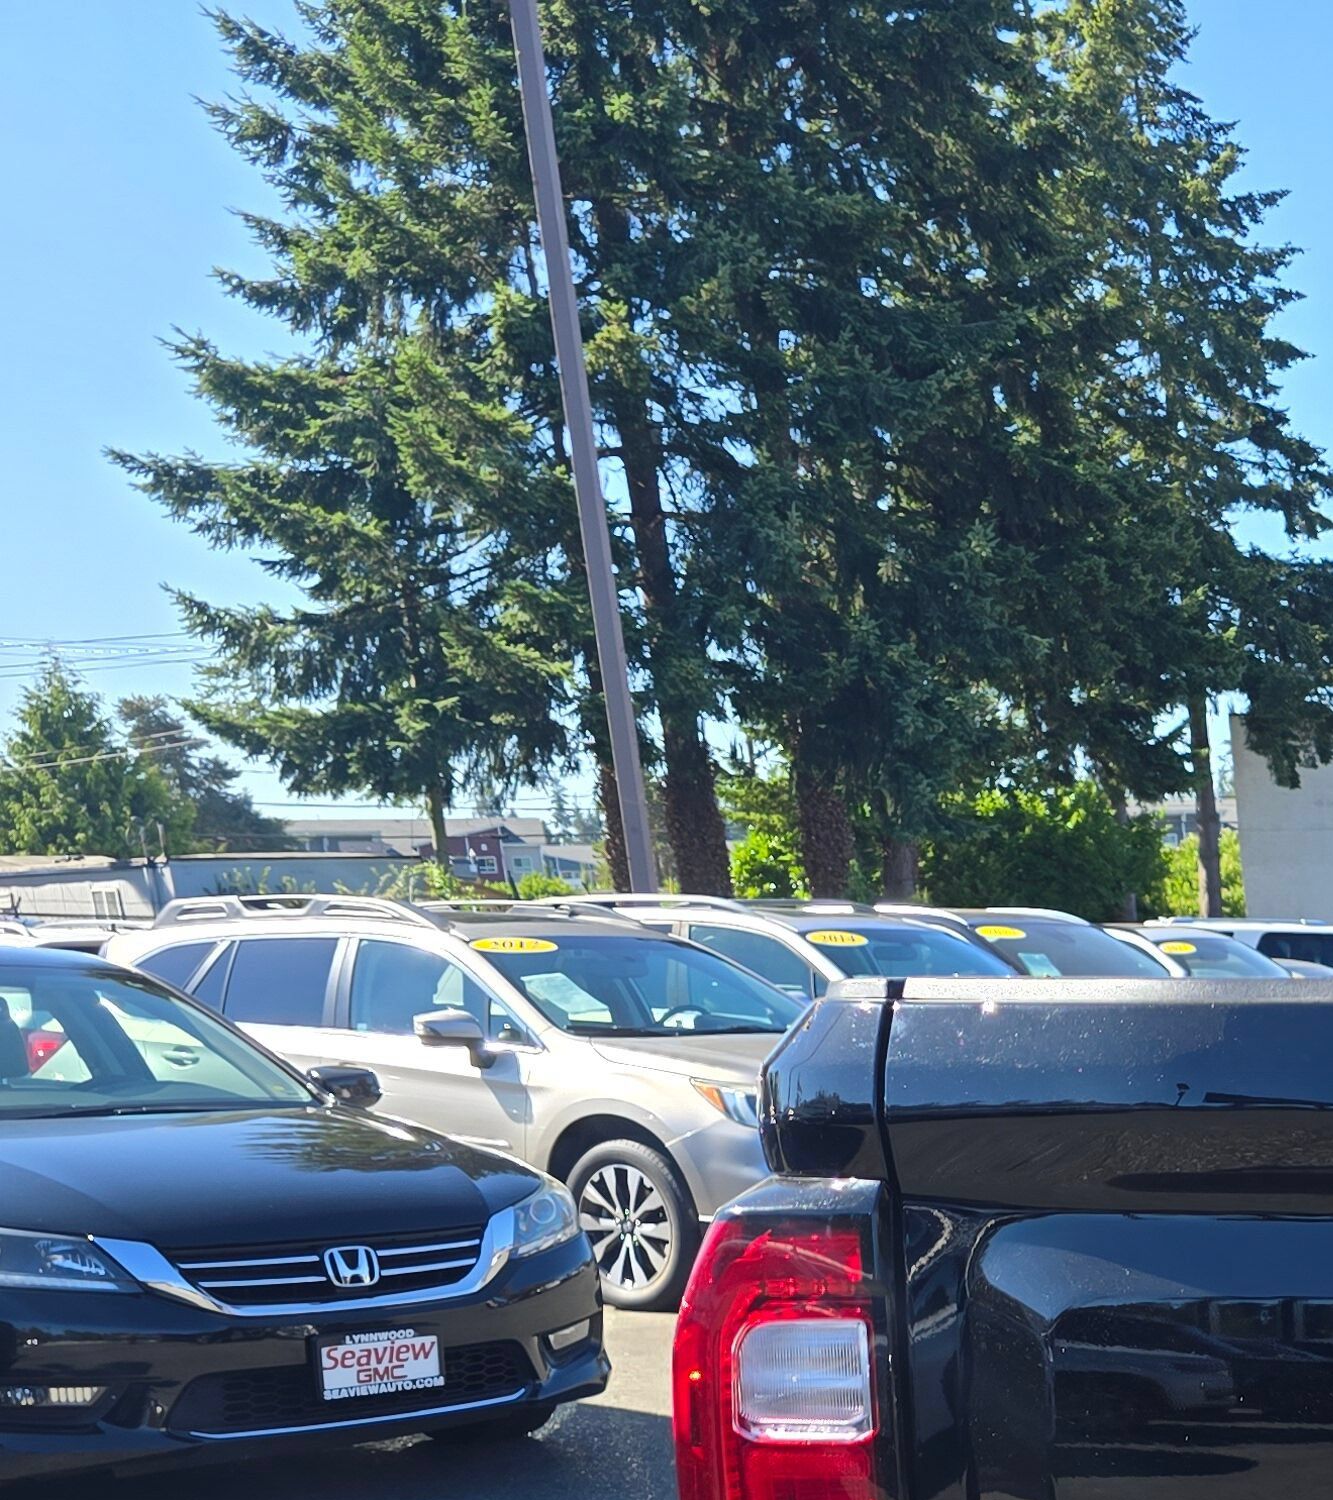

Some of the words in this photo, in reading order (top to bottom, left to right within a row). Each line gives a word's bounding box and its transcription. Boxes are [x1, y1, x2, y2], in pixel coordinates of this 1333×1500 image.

[345, 1328, 415, 1345] LYNNWOOD
[322, 1340, 436, 1370] Seaview
[356, 1364, 408, 1384] GMC
[323, 1376, 446, 1401] SEAVIEWAUTO.COM
